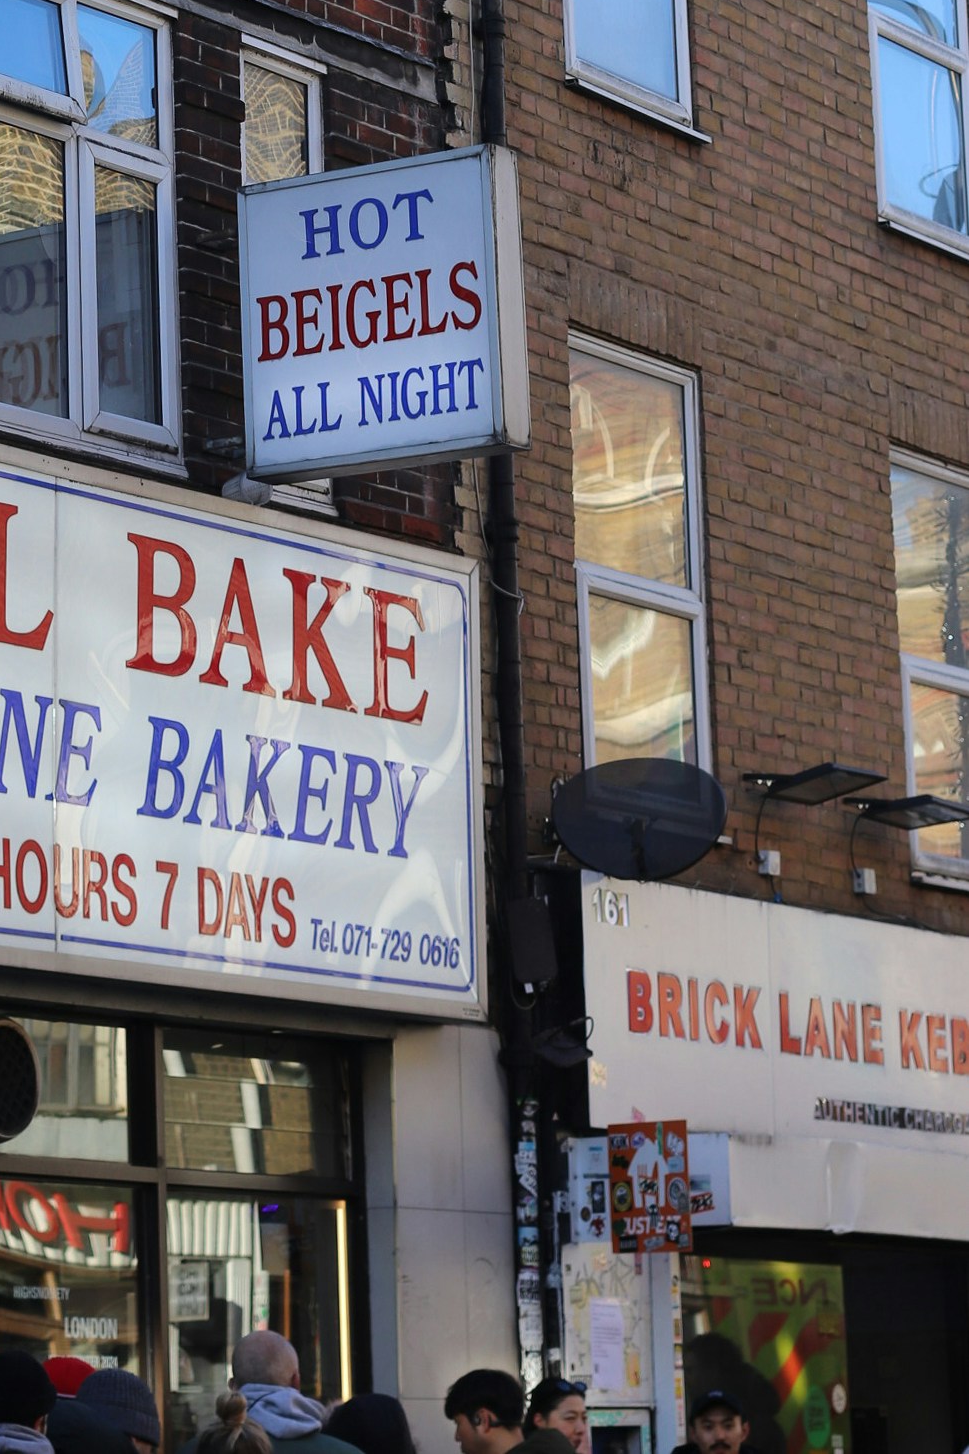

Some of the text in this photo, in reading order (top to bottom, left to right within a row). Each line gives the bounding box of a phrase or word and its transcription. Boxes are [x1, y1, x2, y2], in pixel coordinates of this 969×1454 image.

[299, 189, 434, 260] HOT
[256, 261, 482, 363] BEIGELS
[262, 358, 485, 441] ALL NIGHT
[125, 531, 429, 726] BAKE
[136, 714, 430, 860] BAKERY
[155, 860, 180, 931] 7
[197, 867, 297, 949] DAYS
[591, 887, 630, 928] 161
[419, 933, 461, 970] 0616
[625, 966, 969, 1077] BRICK LANE KEB
[813, 1096, 901, 1129] AUTHENTIC
[63, 1316, 118, 1340] LONDON
